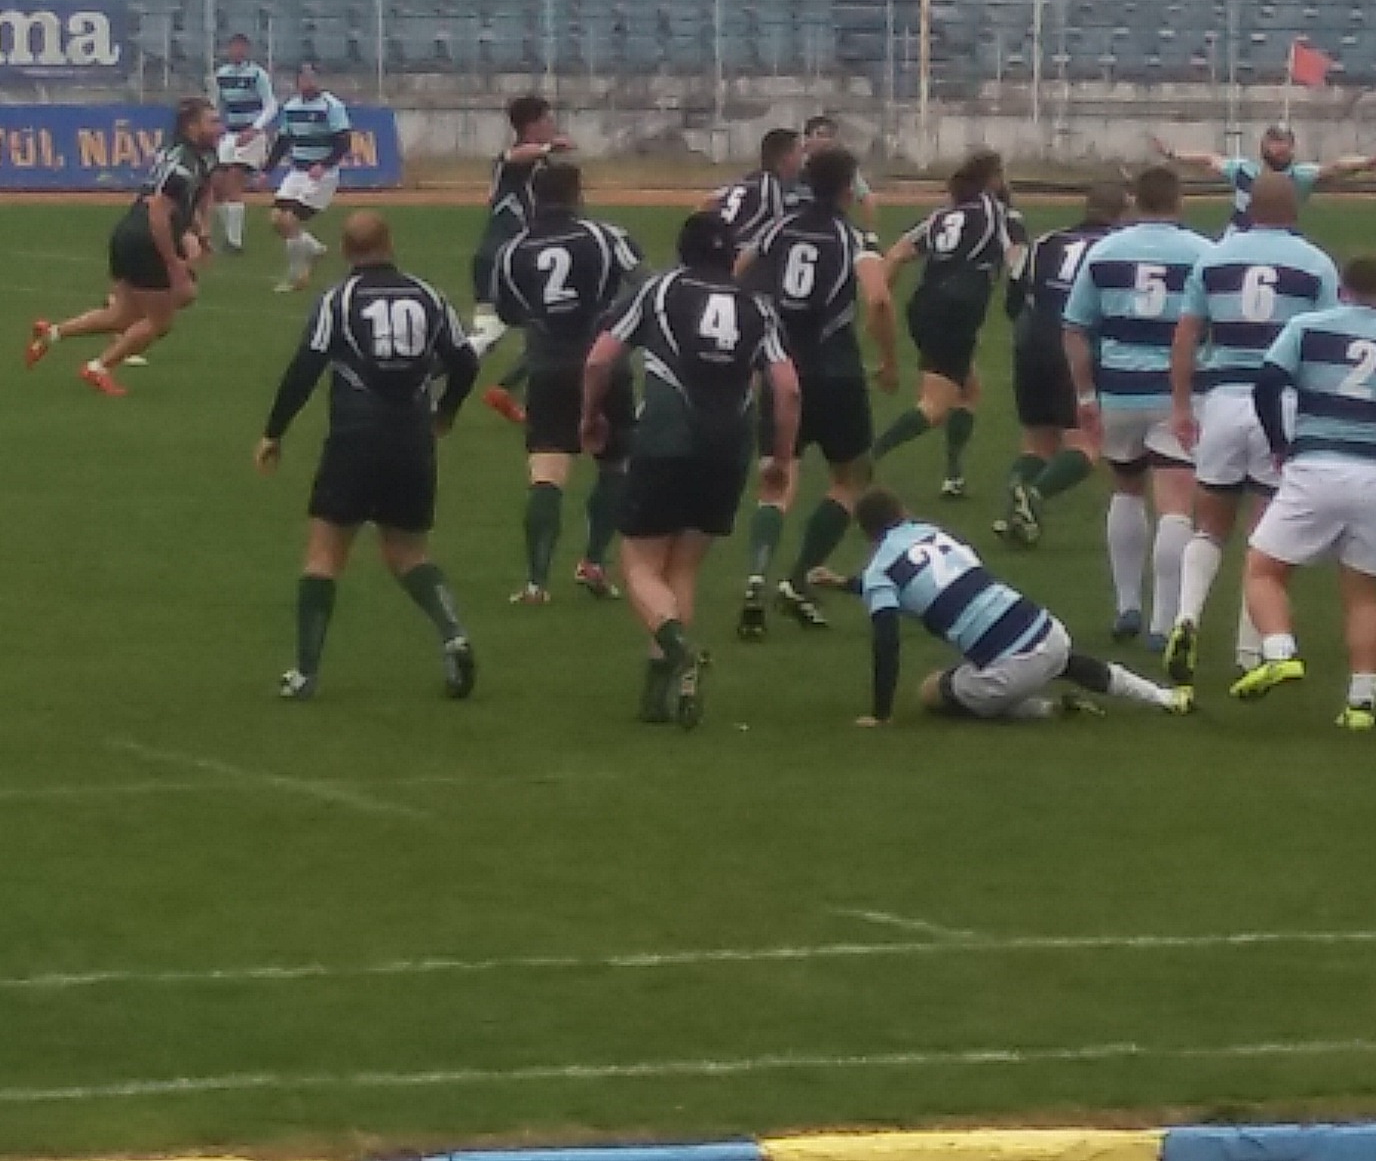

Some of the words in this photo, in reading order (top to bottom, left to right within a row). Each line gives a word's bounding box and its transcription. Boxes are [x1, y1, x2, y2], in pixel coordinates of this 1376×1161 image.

[935, 210, 965, 252] 3
[537, 247, 578, 303] 2
[782, 243, 819, 298] 6
[1134, 263, 1167, 317] 5
[1241, 266, 1278, 322] 6
[361, 299, 426, 357] 10
[699, 293, 739, 350] 4
